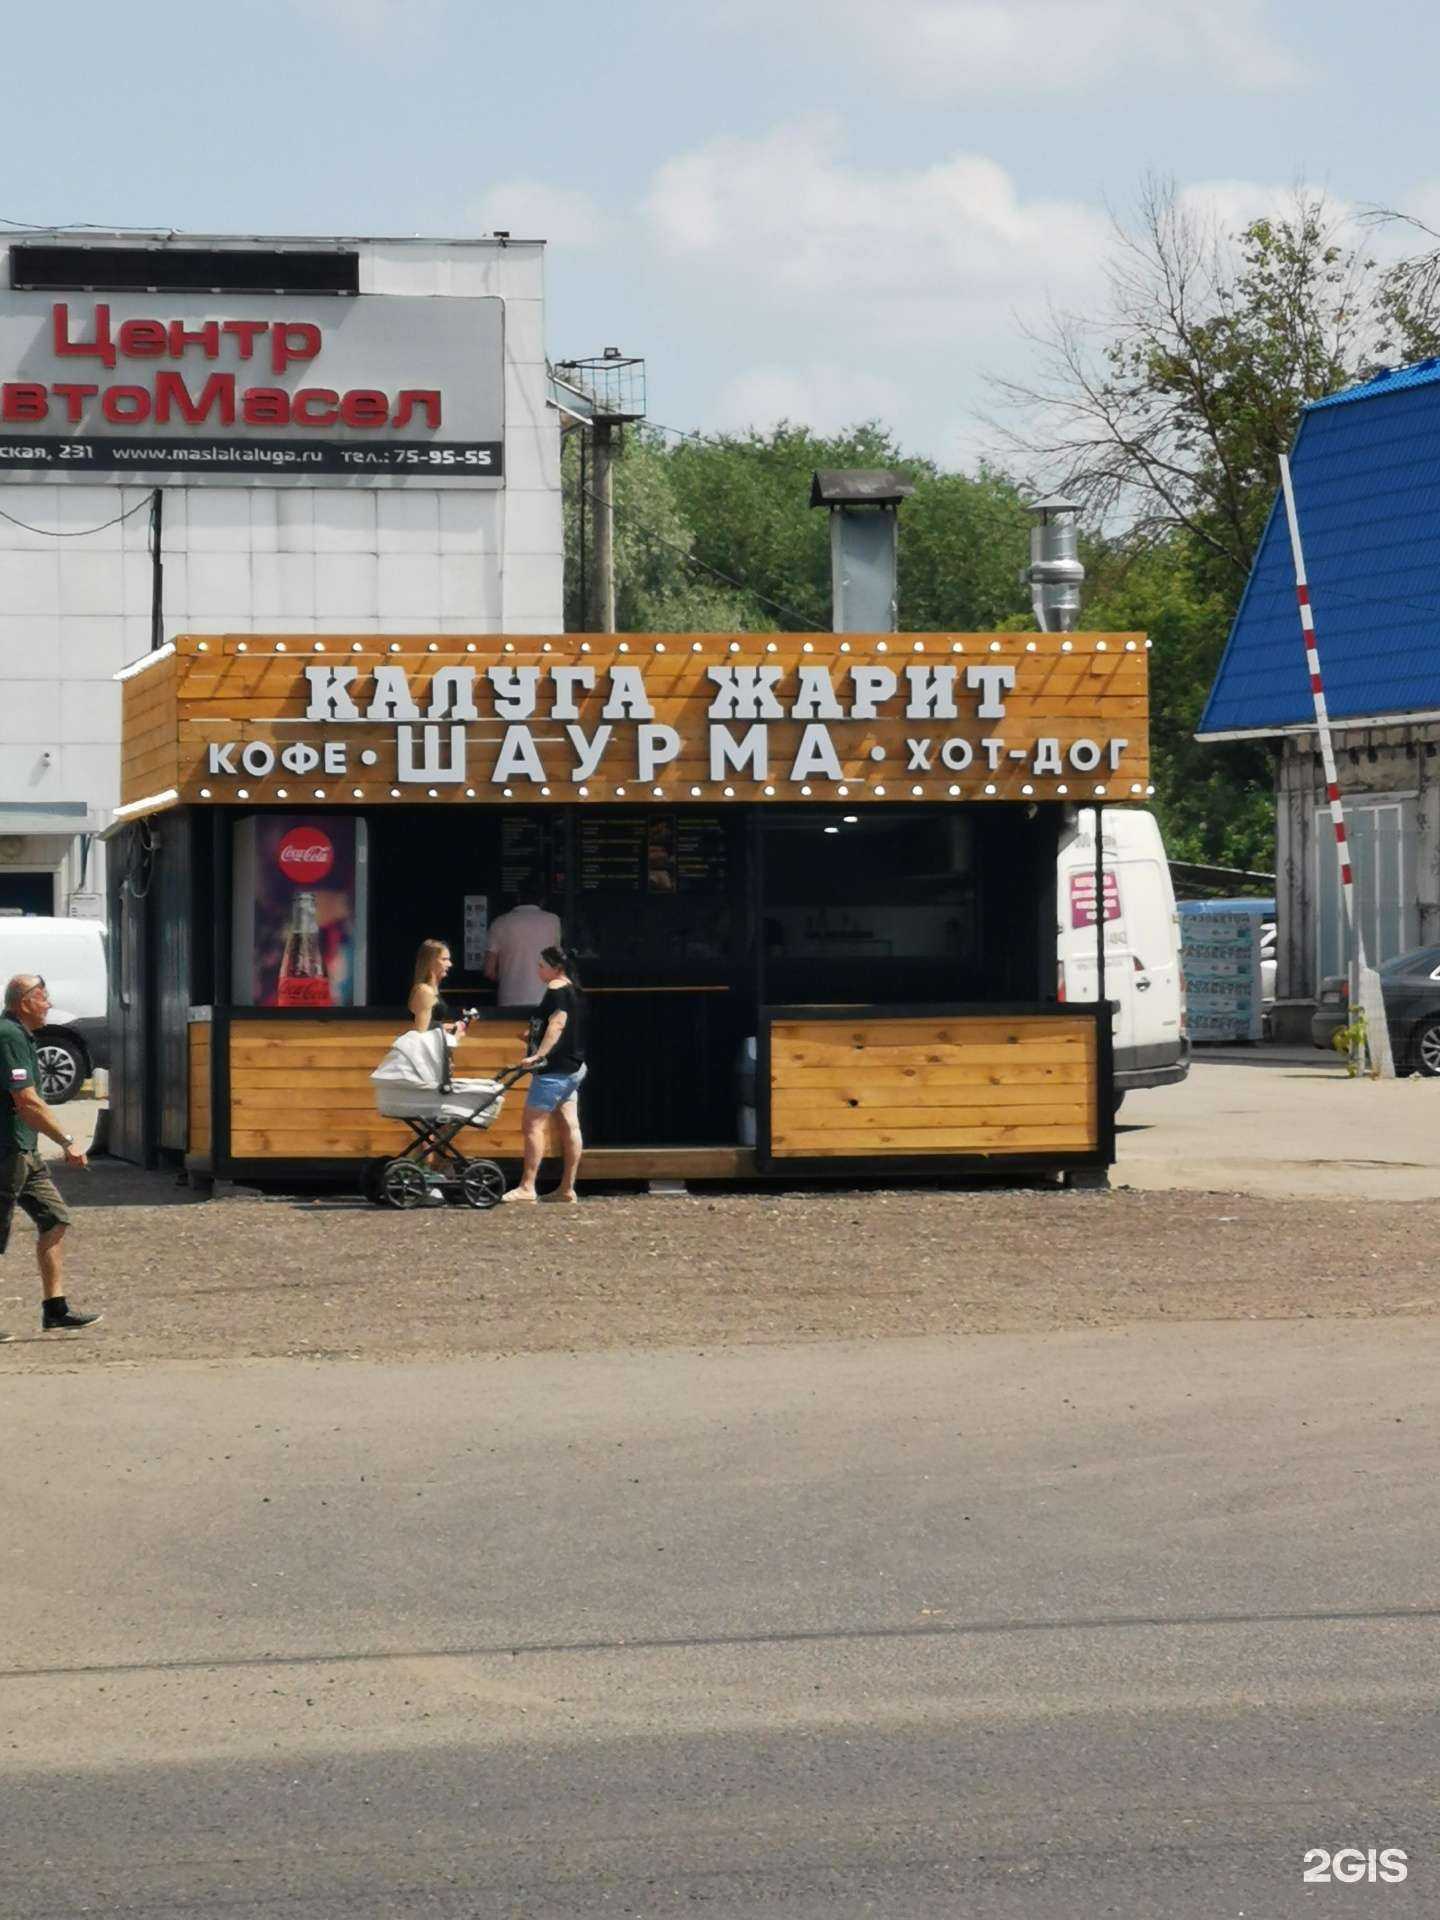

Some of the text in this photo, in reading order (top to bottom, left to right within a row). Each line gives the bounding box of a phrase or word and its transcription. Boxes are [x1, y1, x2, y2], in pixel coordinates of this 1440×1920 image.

[52, 302, 323, 375] Центр
[59, 444, 94, 459] 231
[112, 446, 323, 464] www.maslakaluga.ru
[305, 665, 1016, 721] КАЛУГА ЖАРИТ
[209, 723, 1129, 783] КОФЕ ШАУРМА ХОТ-ДОГ
